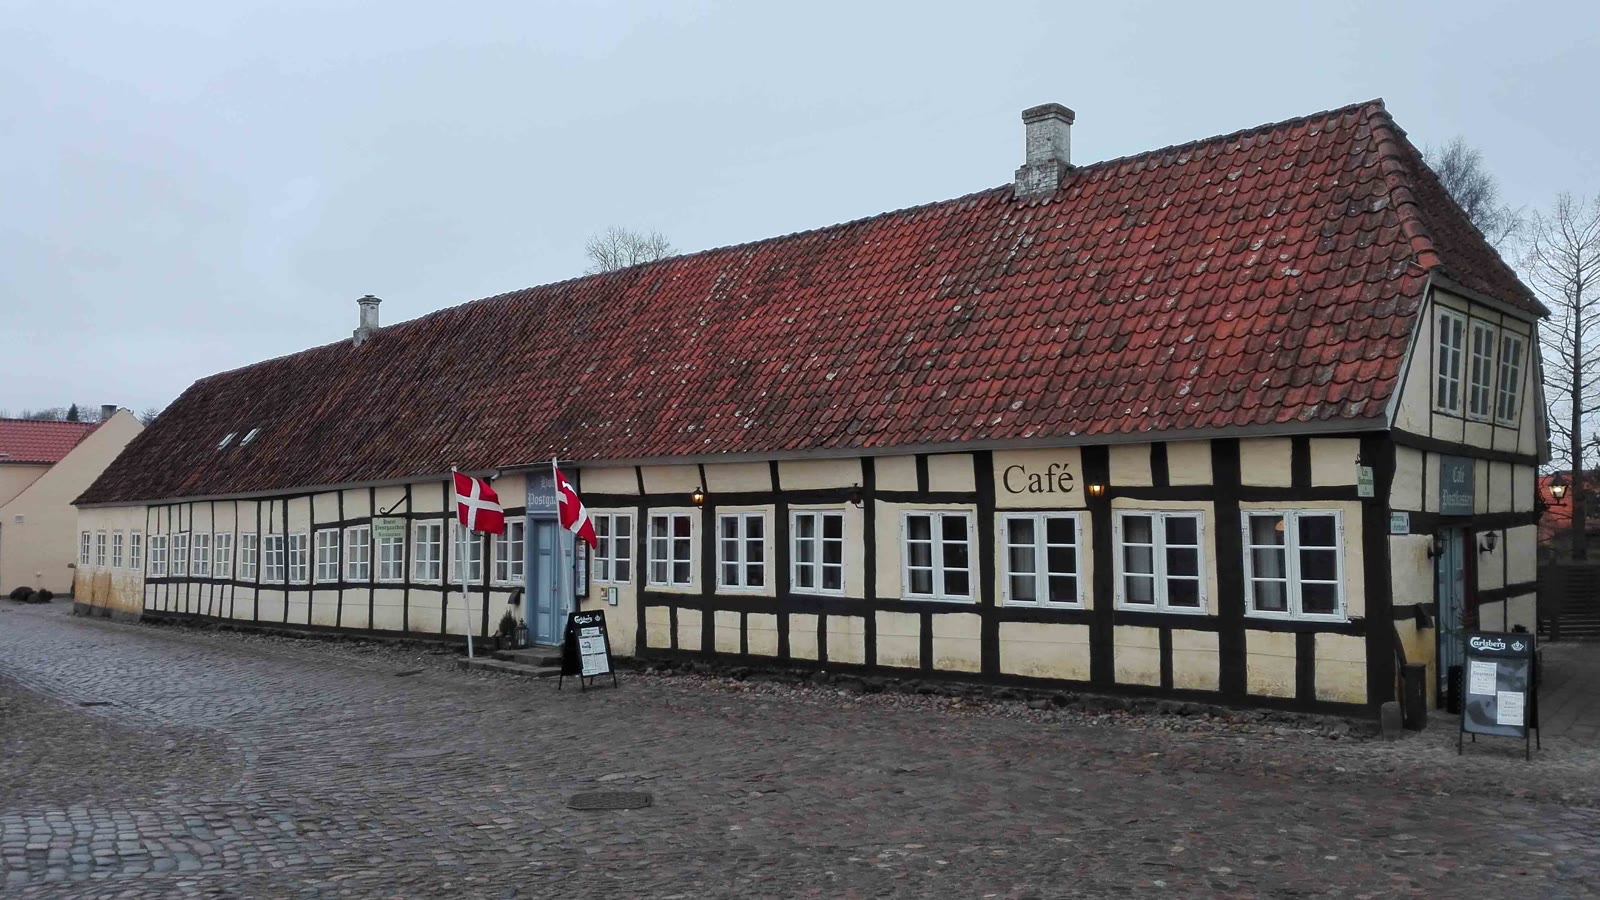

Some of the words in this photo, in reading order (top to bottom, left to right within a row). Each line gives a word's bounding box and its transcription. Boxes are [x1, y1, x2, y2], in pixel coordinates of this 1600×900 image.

[1003, 463, 1074, 494] Café
[574, 614, 593, 625] Carlsberg
[1470, 636, 1506, 651] Carlsberg
